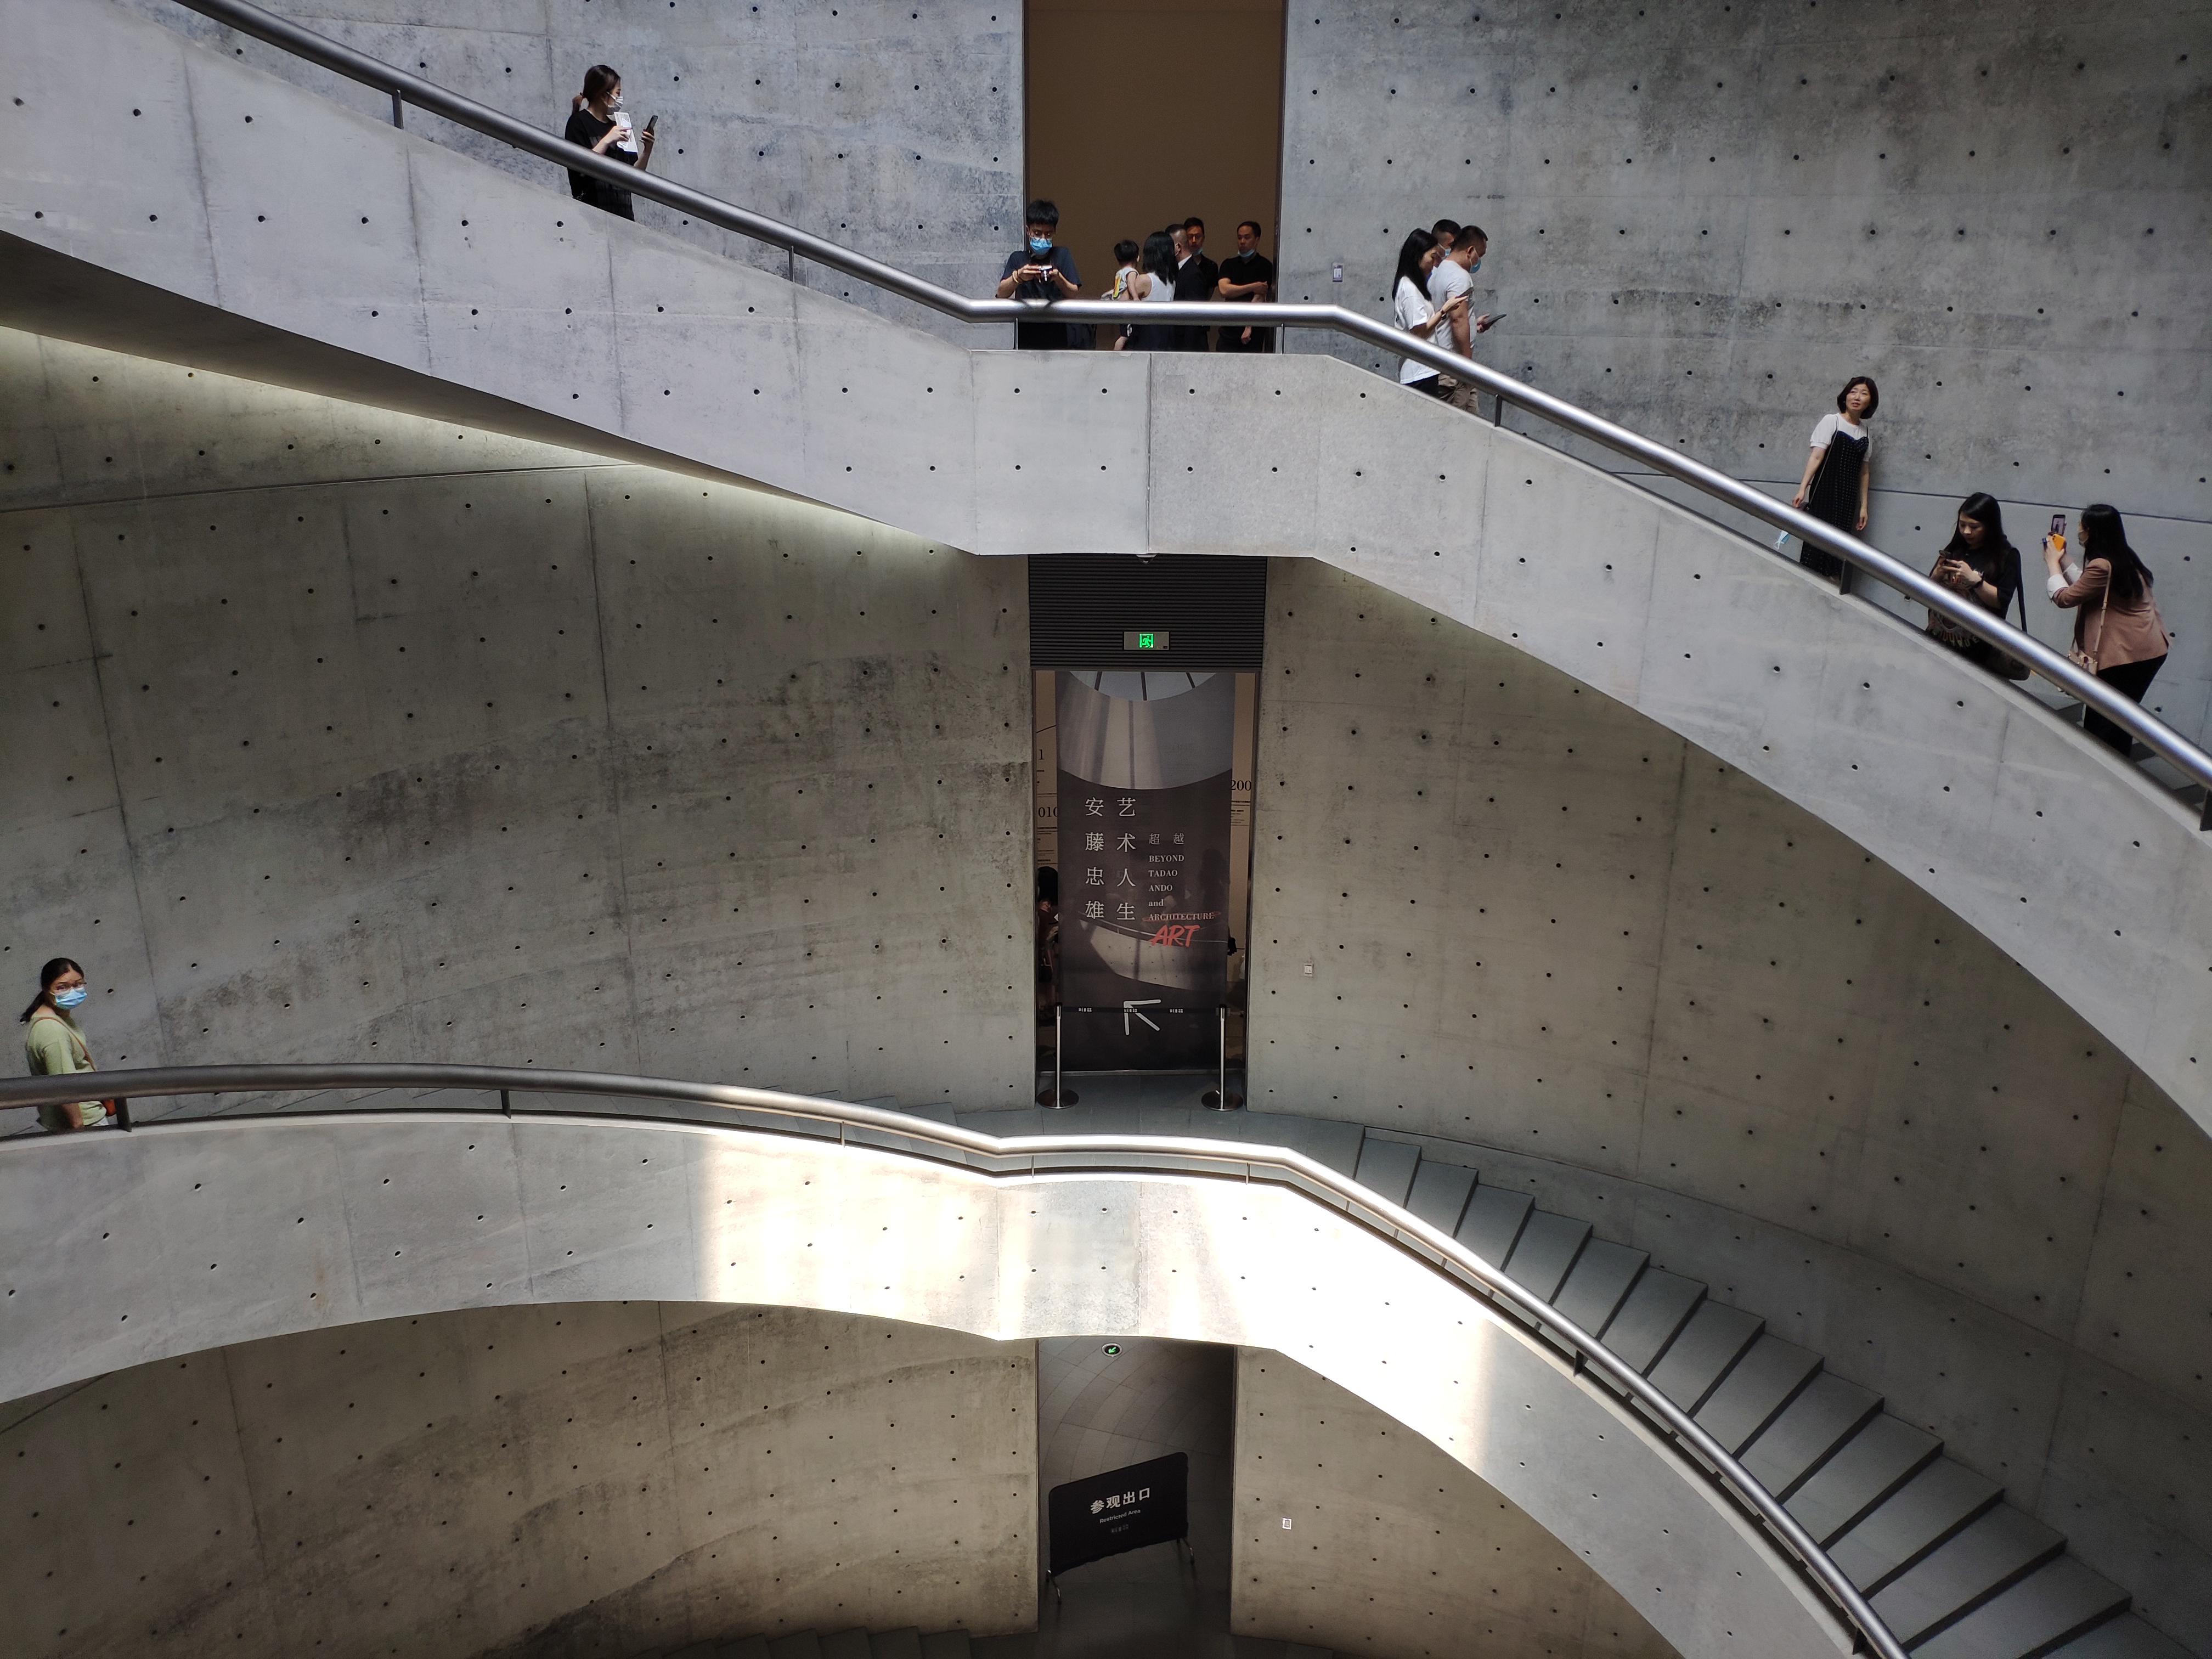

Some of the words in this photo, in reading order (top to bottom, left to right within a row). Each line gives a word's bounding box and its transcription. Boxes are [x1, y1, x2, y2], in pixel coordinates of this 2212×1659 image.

[1148, 833, 1185, 845] 超越
[1085, 797, 1104, 920] 安藤忠雄
[1116, 797, 1136, 921] 艺术人生
[1148, 855, 1184, 863] BEYOND
[1148, 899, 1164, 907] and
[1148, 912, 1215, 921] ARCHITECTURE
[1148, 924, 1200, 947] ART
[1090, 1487, 1150, 1514] 参观出口
[1099, 1512, 1127, 1524] Restricted
